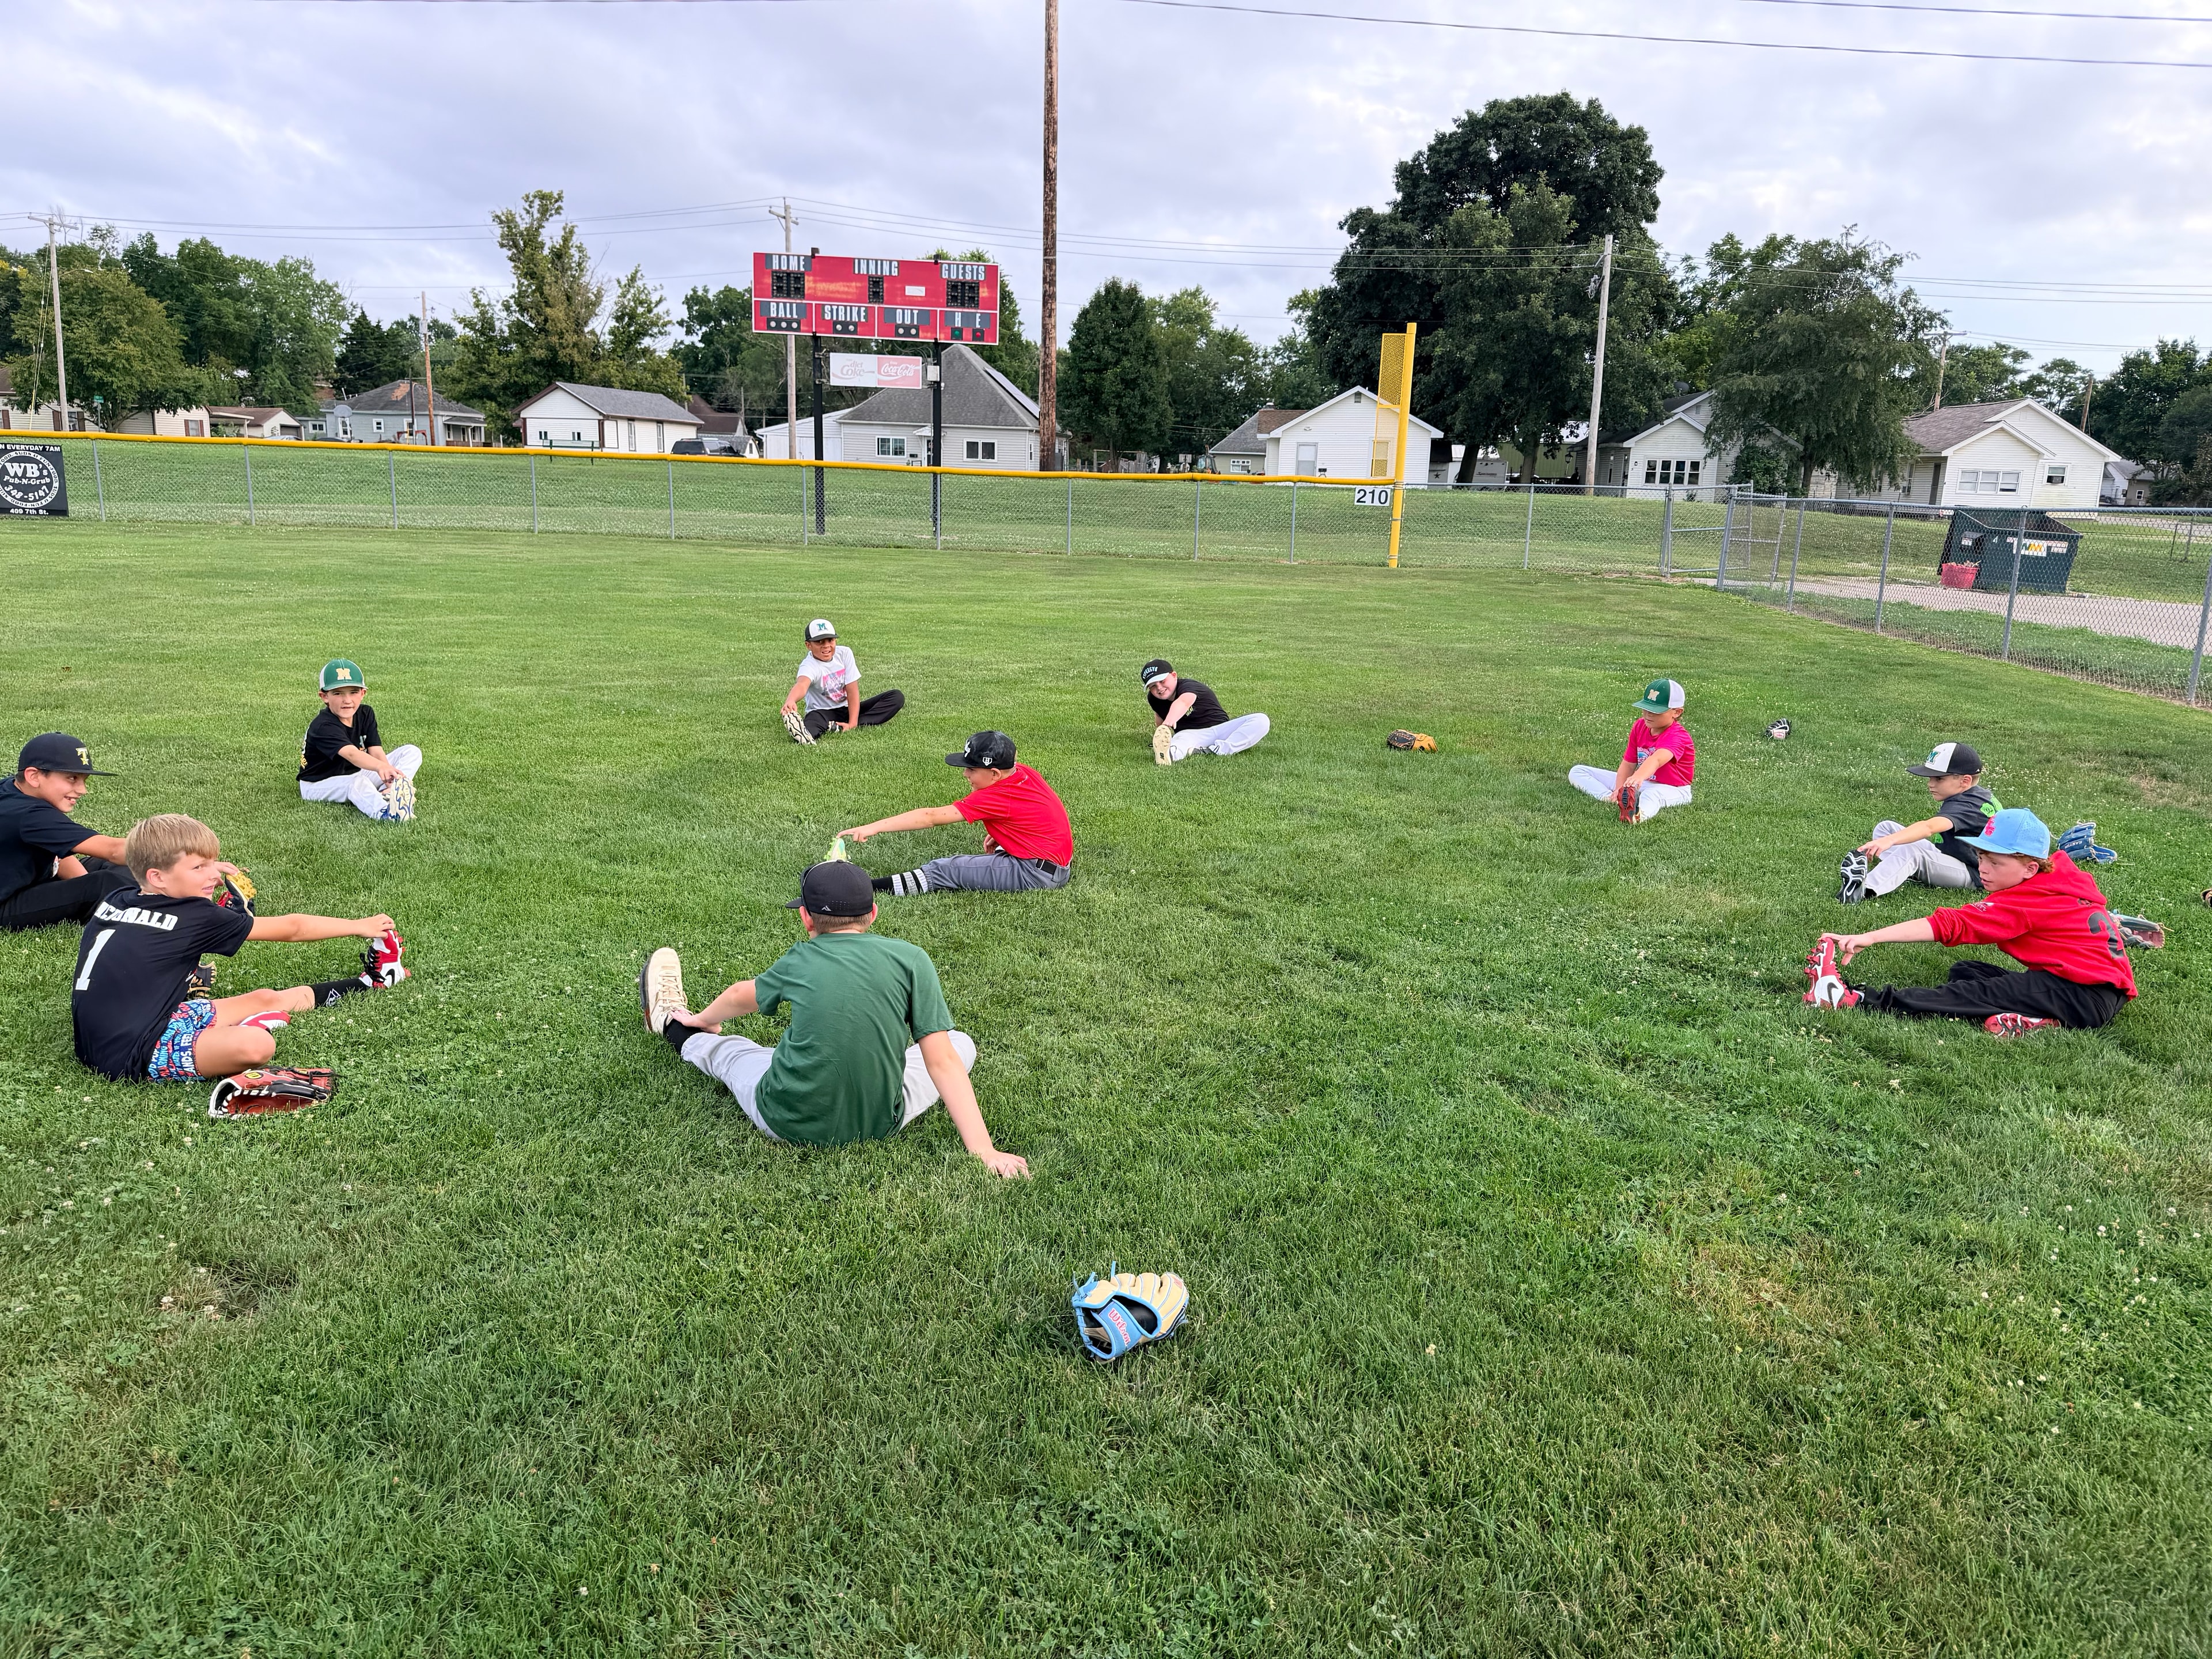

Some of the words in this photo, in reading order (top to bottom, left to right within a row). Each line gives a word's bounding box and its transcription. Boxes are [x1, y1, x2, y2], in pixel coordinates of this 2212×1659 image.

[772, 255, 805, 271] HOME
[854, 259, 899, 276] INNING
[942, 263, 985, 281] GUESTS
[770, 302, 798, 318] BALL
[824, 305, 866, 322] STRIKE
[896, 309, 918, 324] OUT
[955, 312, 961, 327] H
[976, 313, 981, 328] E
[840, 365, 865, 377] Coke
[4, 463, 48, 478] WB's
[4, 485, 49, 501] 348-5147
[1356, 488, 1388, 505] 210
[816, 623, 827, 631] M
[336, 668, 352, 680] M
[1647, 690, 1660, 701] M
[1926, 751, 1940, 763] M
[75, 929, 116, 991] 1
[1108, 1308, 1131, 1346] Wilson
